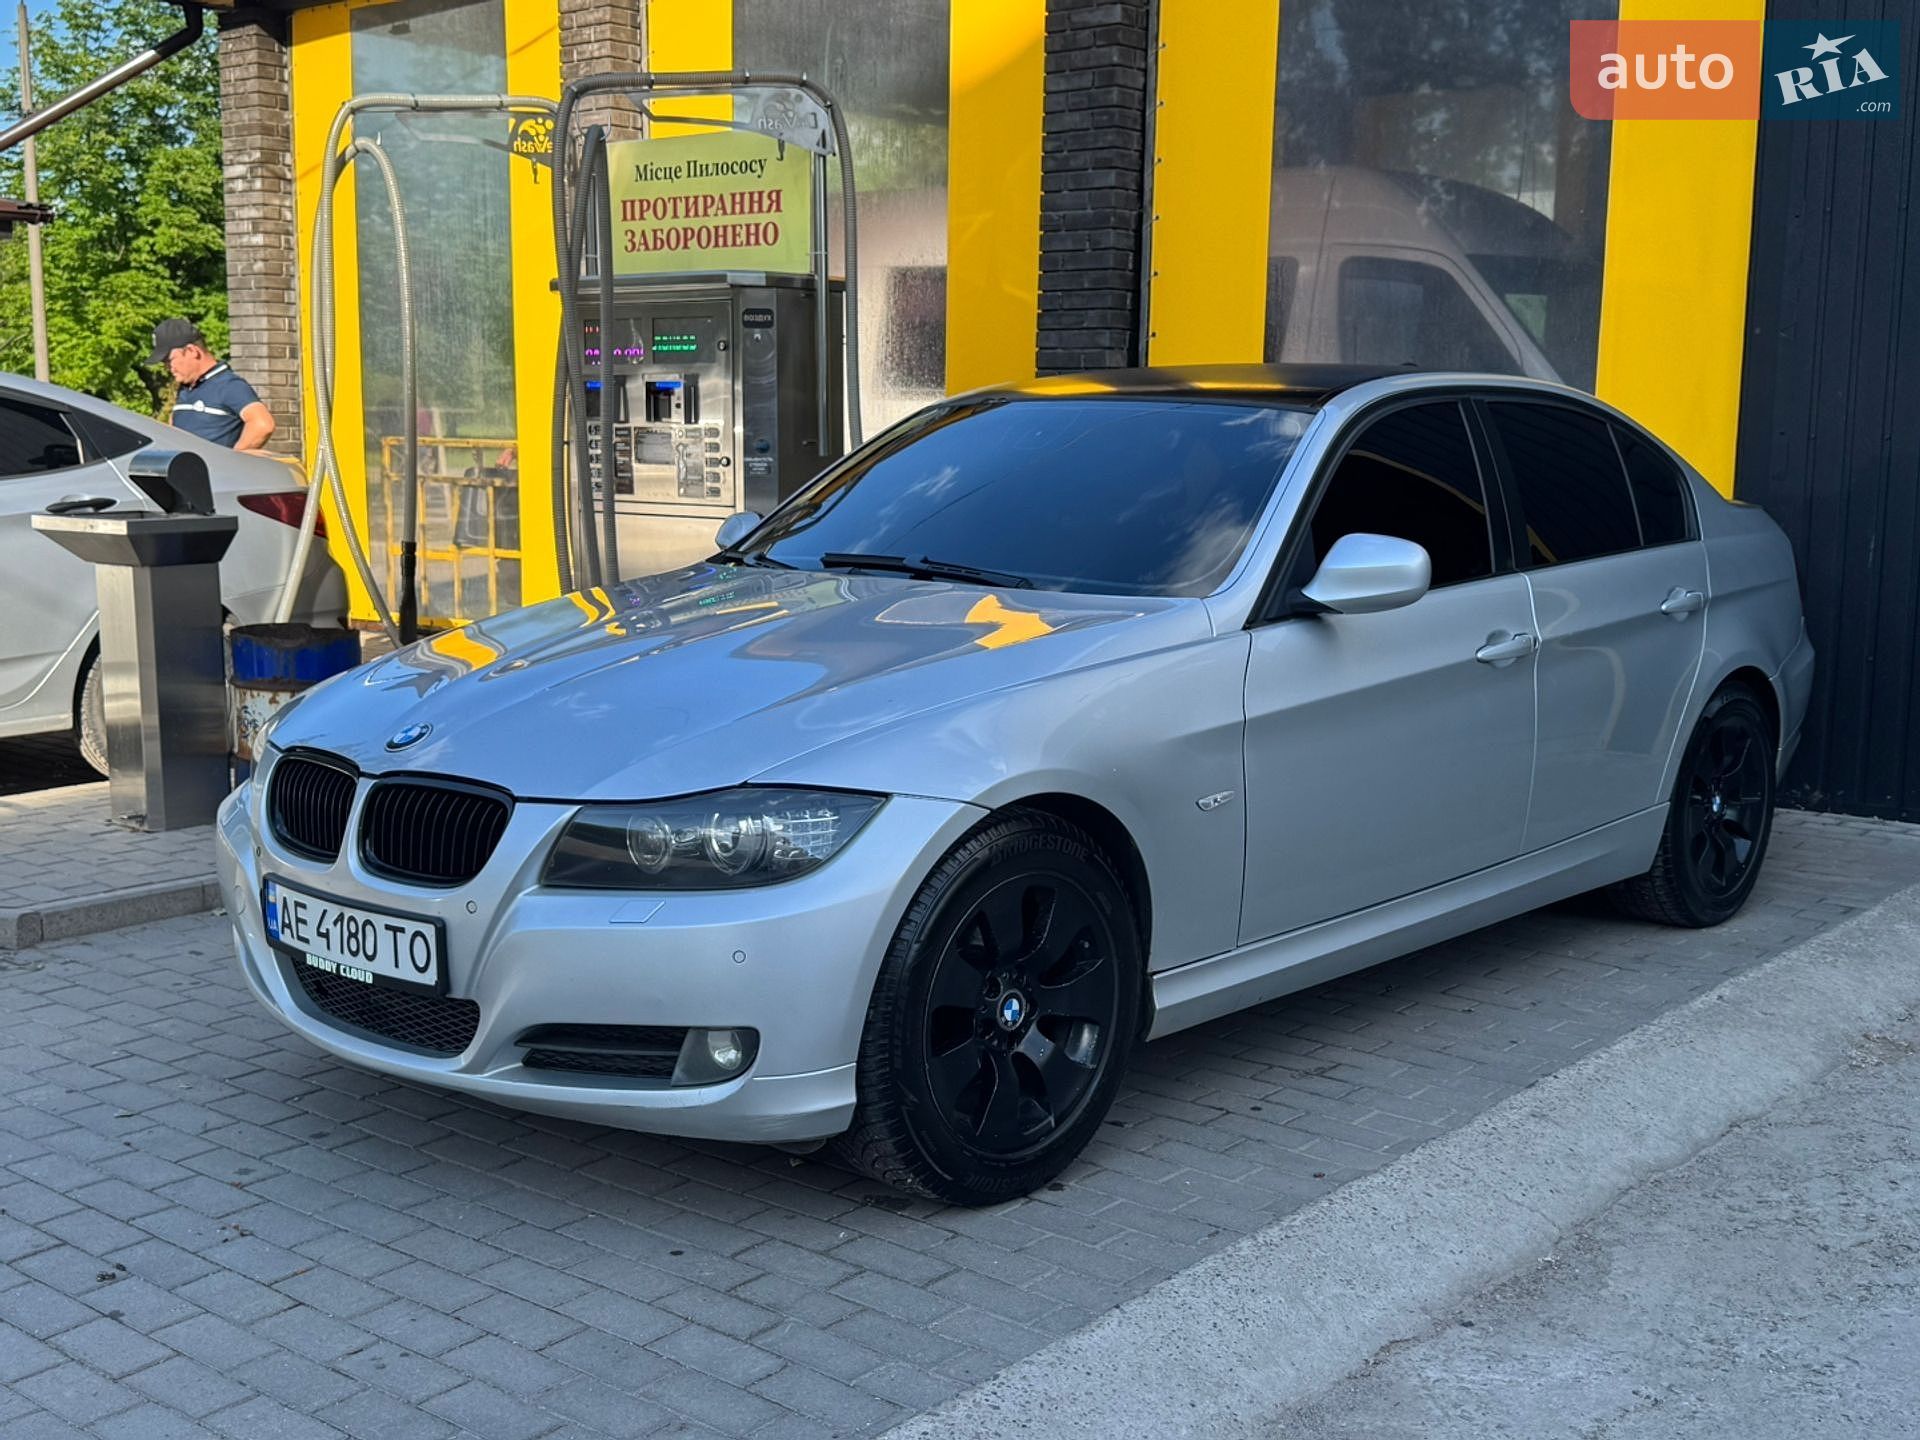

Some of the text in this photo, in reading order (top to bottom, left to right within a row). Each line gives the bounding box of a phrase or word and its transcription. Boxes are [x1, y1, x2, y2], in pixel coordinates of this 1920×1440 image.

[634, 155, 768, 184] Місце Пилососу
[620, 188, 784, 223] ПРОТИРАННЯ
[623, 220, 780, 254] ЗАБОРОНЕНО
[280, 895, 432, 974] AE 4180 TO
[339, 964, 374, 984] CLOUD
